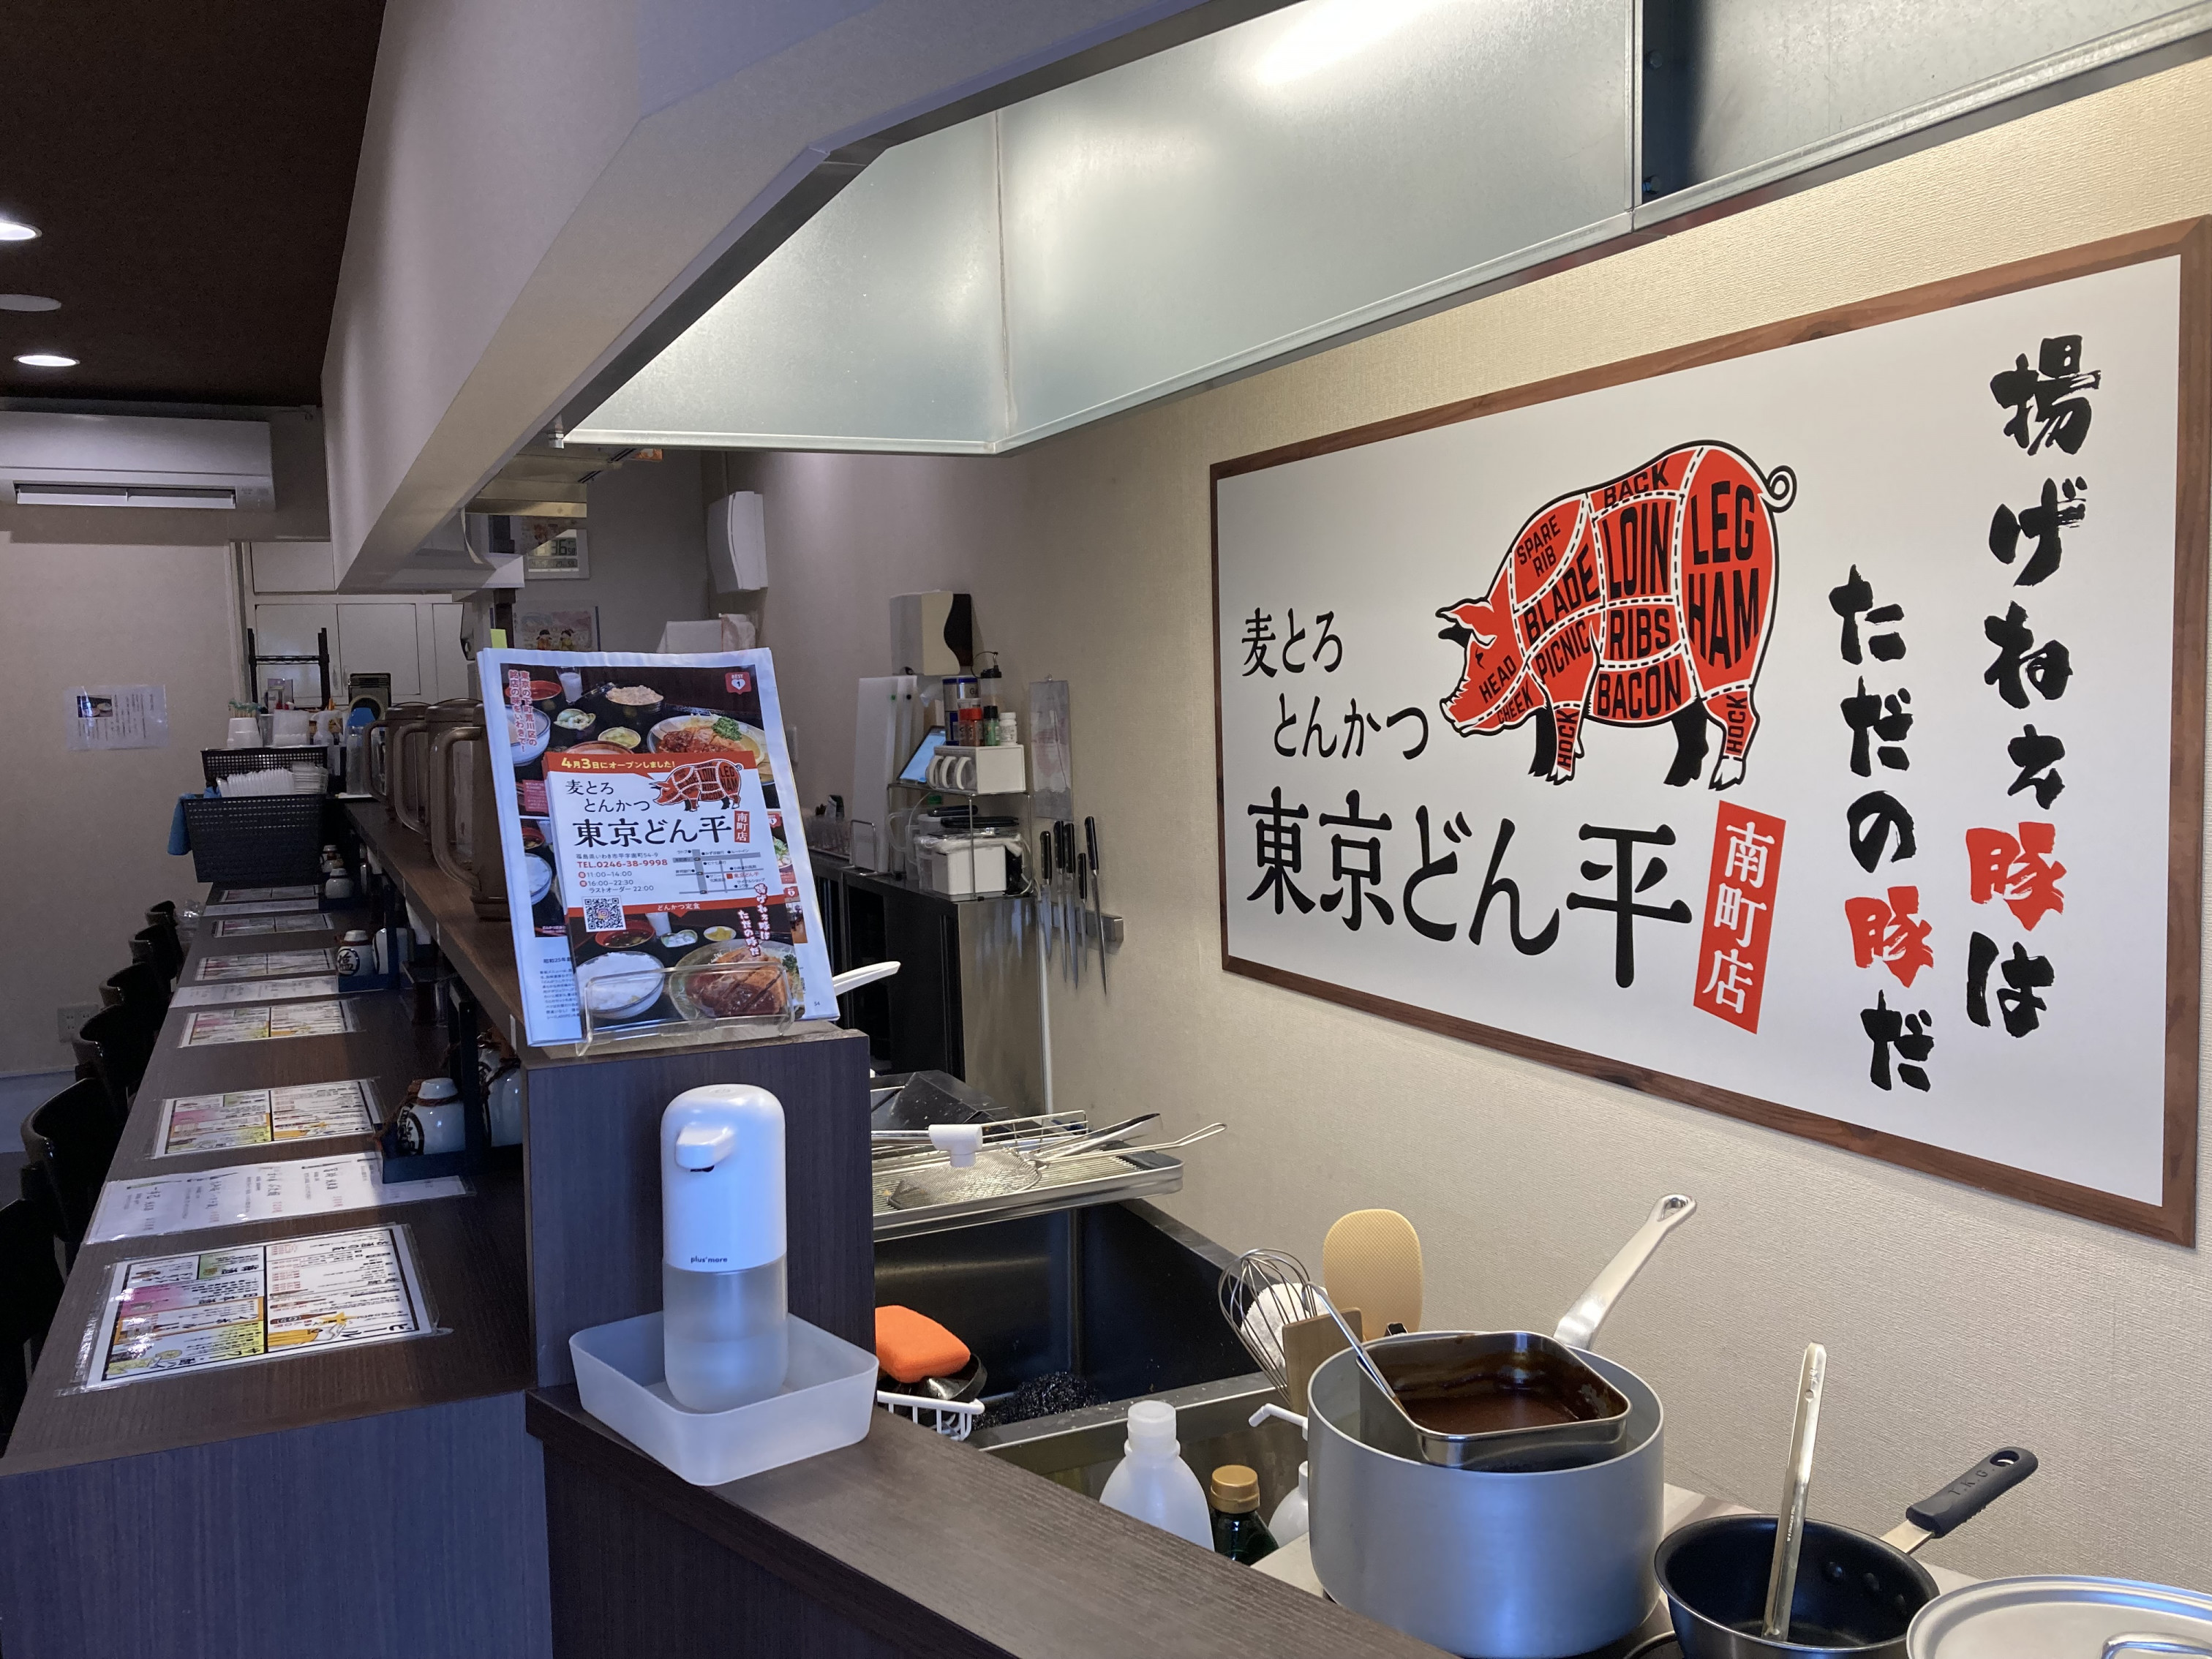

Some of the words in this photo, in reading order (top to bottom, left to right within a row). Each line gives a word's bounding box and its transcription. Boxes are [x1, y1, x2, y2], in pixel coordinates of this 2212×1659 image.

[1604, 458, 1669, 509] BACK
[1516, 514, 1560, 565] SPARE
[1602, 502, 1670, 599] LOIN
[1691, 481, 1755, 565] LEG
[1533, 546, 1557, 578] RIB
[1524, 543, 1600, 648] BLADE
[1688, 568, 1759, 670] HAM
[1241, 608, 1343, 678] 麦とろ
[1538, 620, 1592, 684] PICNIC
[1610, 608, 1671, 661] RIBS
[1478, 655, 1516, 704] HEAD
[1497, 681, 1533, 725] CHEEK
[1598, 659, 1682, 720] BACON
[1274, 692, 1429, 760] とんかつ
[1558, 708, 1579, 767] HOCK
[1726, 694, 1748, 754] HOCK
[565, 779, 614, 795] 麦とろ
[584, 798, 650, 812] とんかつ
[572, 816, 732, 848] 東京どん平
[736, 812, 748, 841] 南町店
[1829, 563, 1935, 1091] ただの豚だ
[576, 859, 668, 868] TEL.0246-38-9998
[1246, 786, 1692, 988] 東京どん平
[1701, 821, 1775, 1015] 南町店
[341, 1322, 413, 1339] ビール
